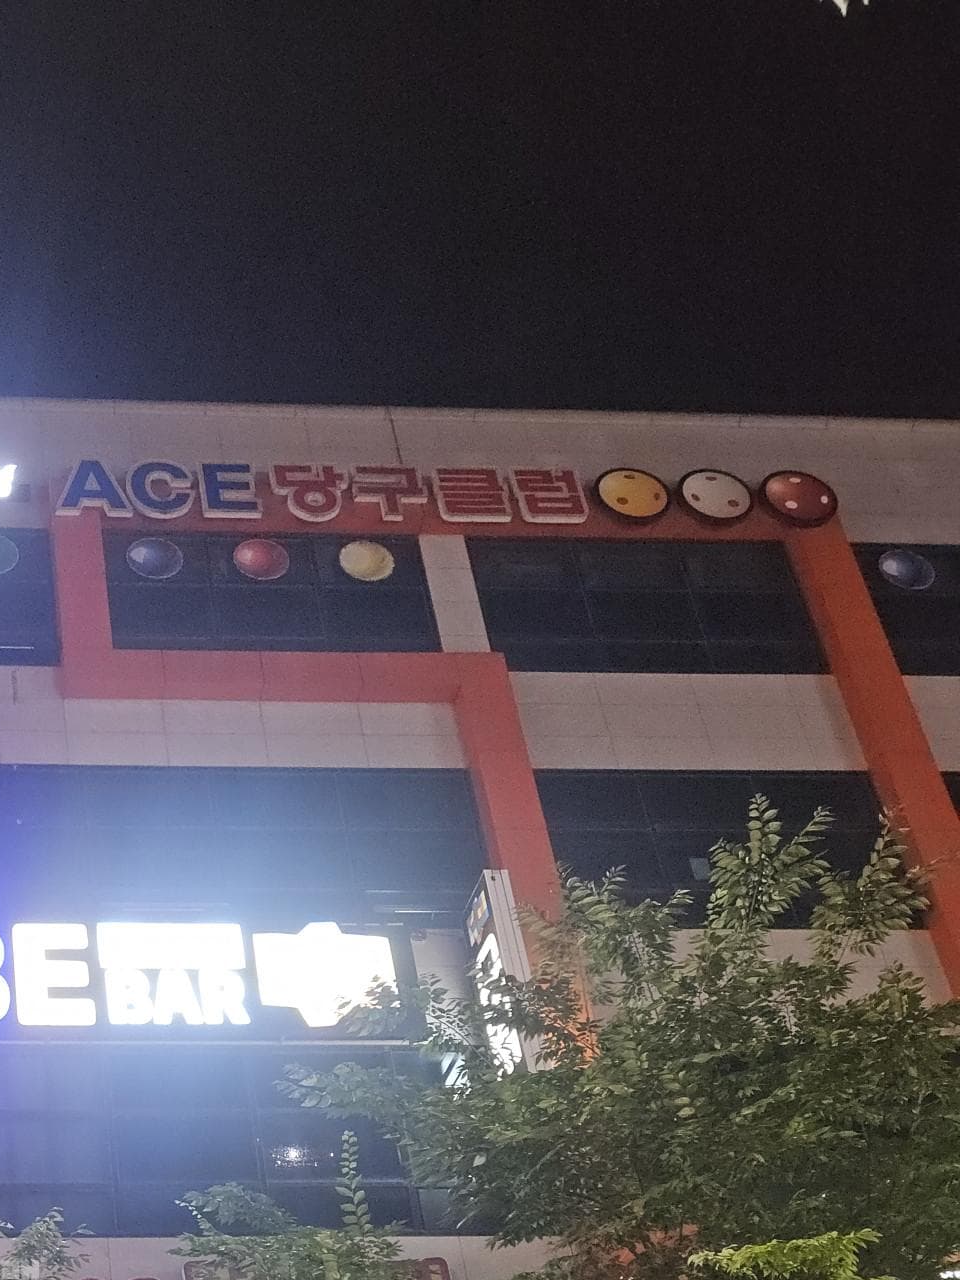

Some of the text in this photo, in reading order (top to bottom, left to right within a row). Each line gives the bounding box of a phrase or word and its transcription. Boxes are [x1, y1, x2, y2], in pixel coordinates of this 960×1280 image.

[55, 459, 589, 525] ACE 당구클럽
[104, 968, 251, 1025] BAR
